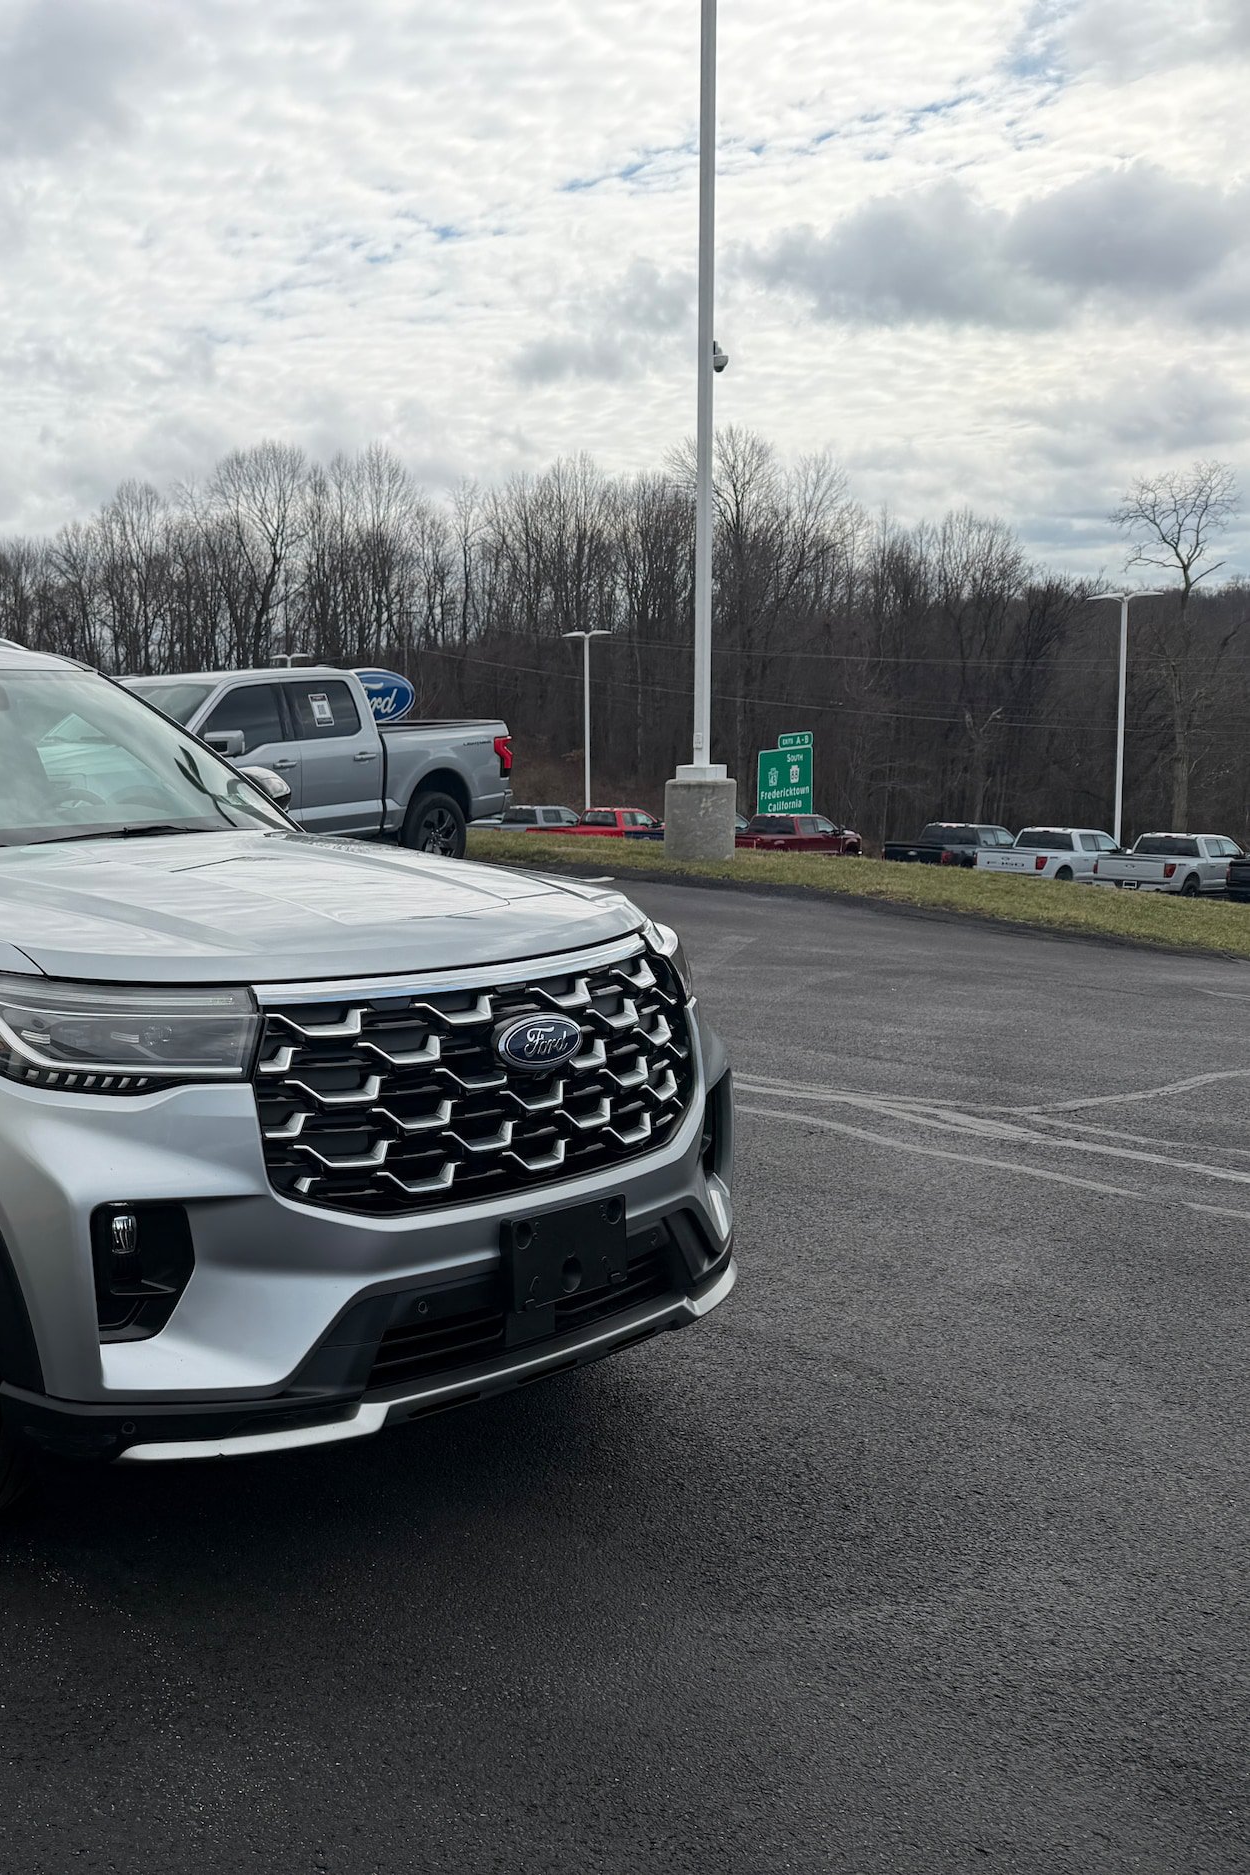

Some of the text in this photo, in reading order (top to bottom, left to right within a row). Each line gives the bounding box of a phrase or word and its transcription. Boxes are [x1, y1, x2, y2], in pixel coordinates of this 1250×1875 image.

[760, 786, 810, 801] Fredericktown
[767, 799, 803, 812] California
[523, 1026, 569, 1058] Ford
